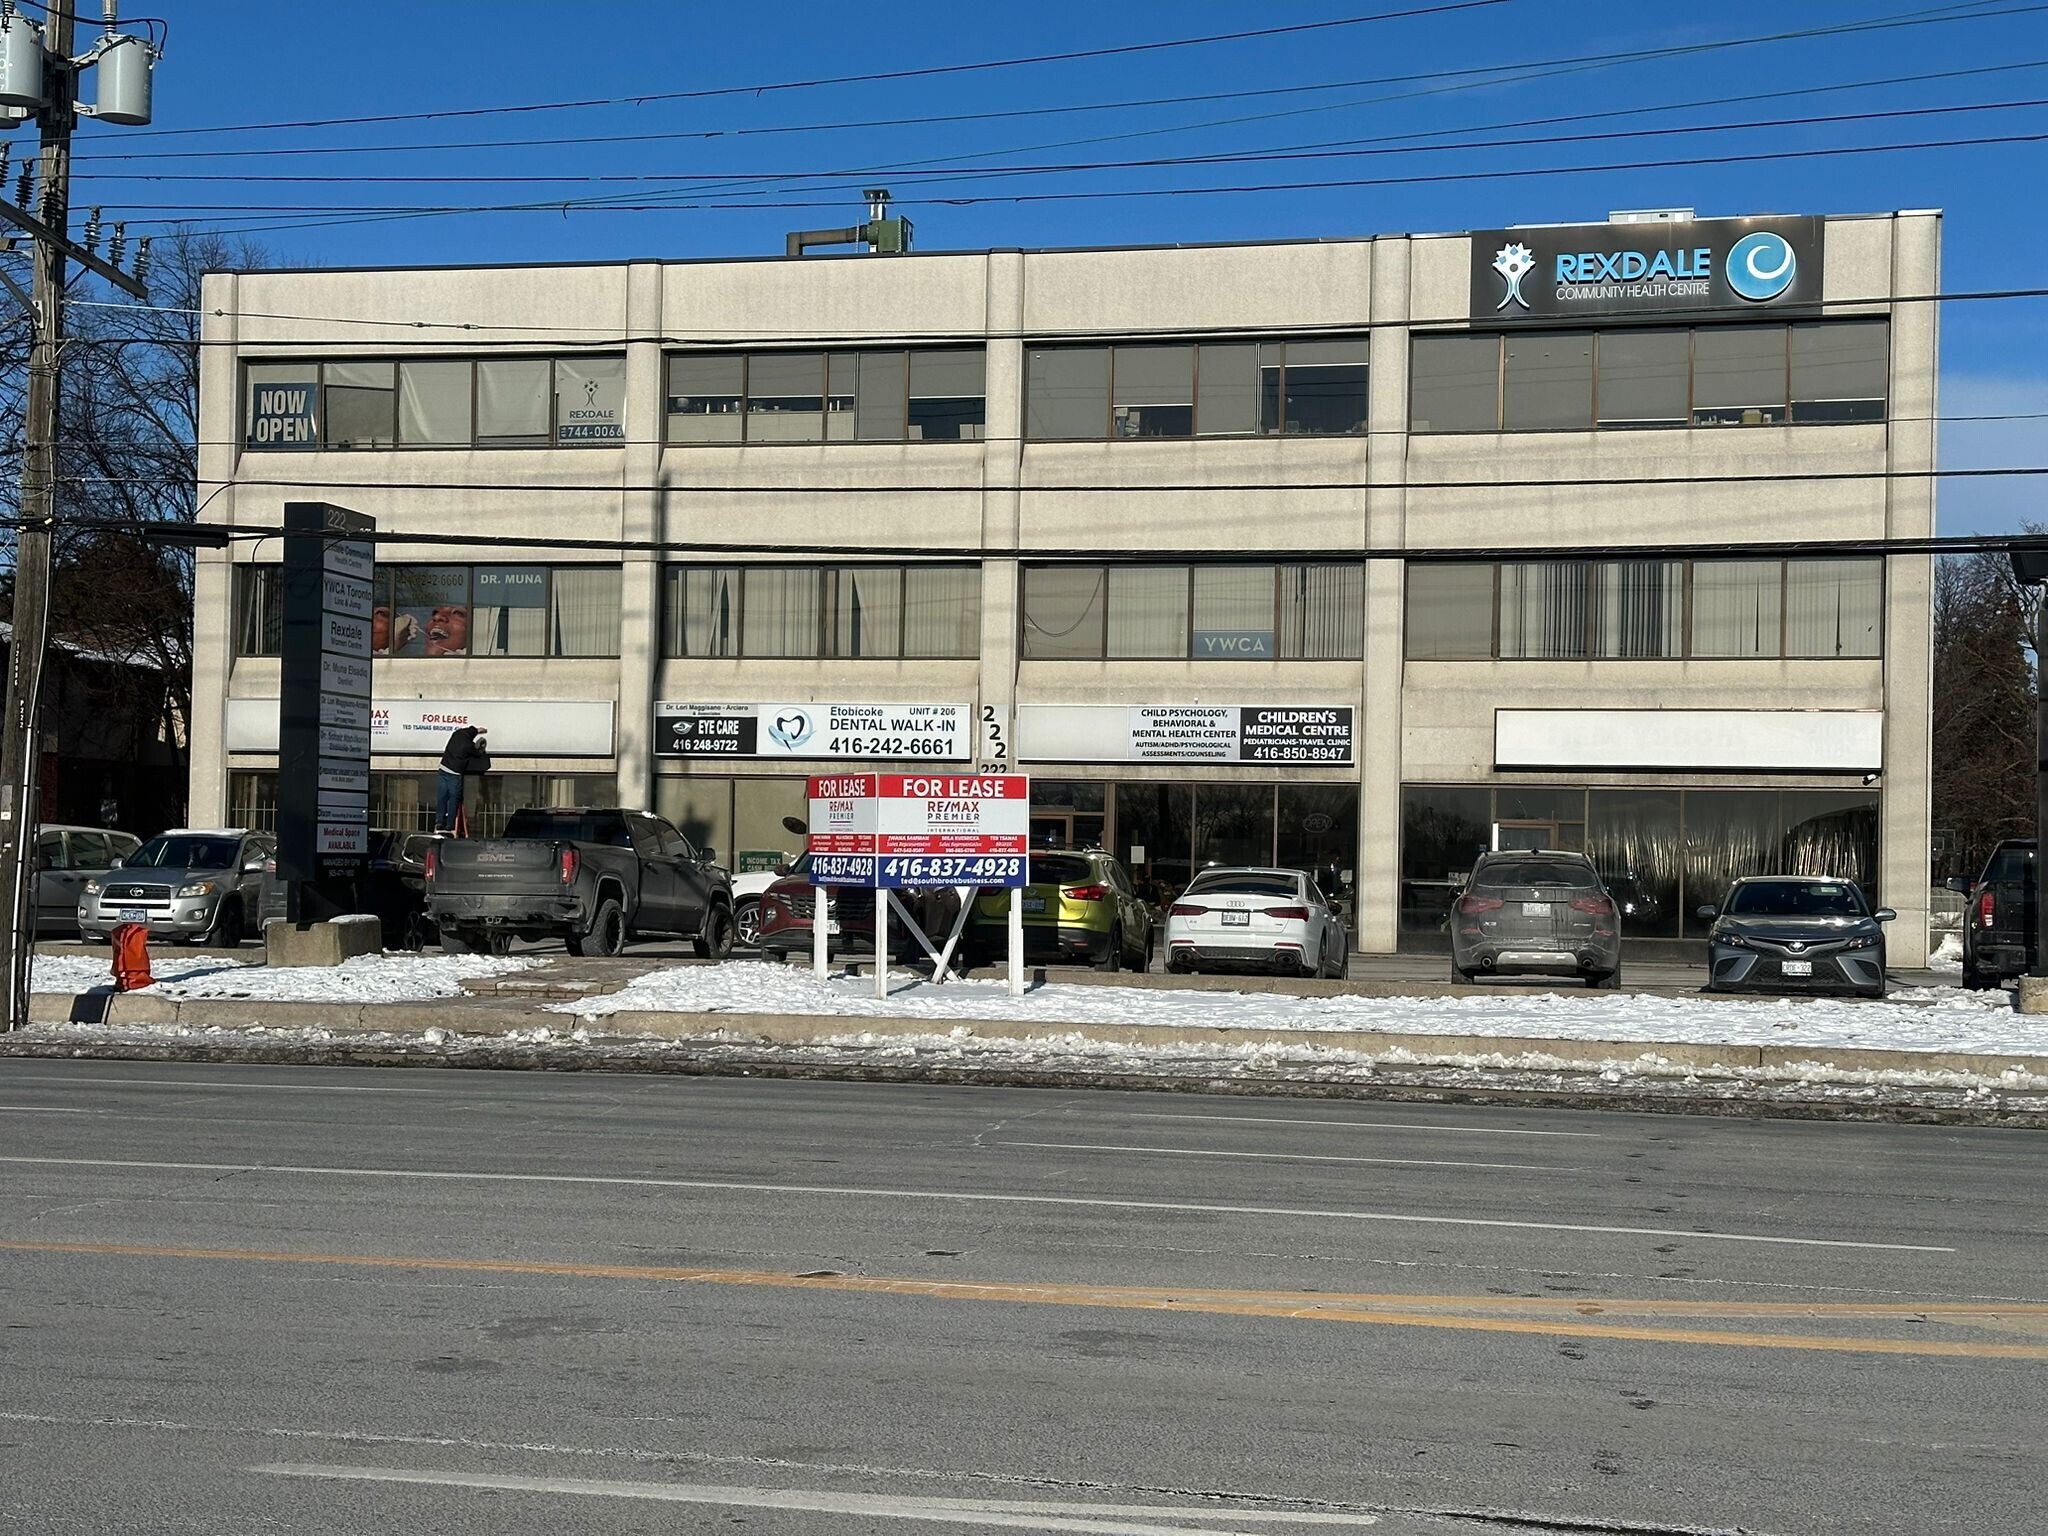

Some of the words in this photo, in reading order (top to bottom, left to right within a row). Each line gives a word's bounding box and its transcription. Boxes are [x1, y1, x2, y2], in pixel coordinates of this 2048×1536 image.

[1557, 248, 1711, 283] REXDALE
[1556, 286, 1626, 301] COMMUNITY
[1627, 284, 1667, 298] HEALTH
[1668, 282, 1710, 296] CENTRE
[260, 390, 307, 415] NOW
[569, 410, 614, 419] REXDALE
[256, 417, 308, 442] OPEN
[567, 426, 622, 438] 744-0066
[327, 509, 347, 531] 222
[480, 574, 501, 585] DR.
[505, 574, 542, 585] MUNA
[324, 579, 346, 596] YWCA
[347, 584, 372, 602] Toronto
[330, 621, 362, 640] Rexdale
[1204, 637, 1265, 652] YWCA
[830, 706, 884, 717] Etobicoke
[909, 707, 931, 716] UNIT
[1141, 709, 1167, 717] CHILD
[1168, 709, 1228, 718] PSYCHOLOGY,
[1257, 710, 1337, 723] CHILDREN'S
[422, 714, 440, 723] FOR
[442, 715, 468, 724] LEASE
[830, 718, 887, 731] DENTAL
[891, 719, 934, 732] WALK
[1153, 719, 1208, 728] BEHAVIORAL
[1209, 720, 1216, 728] &
[698, 719, 715, 735] EYE
[716, 719, 739, 735] CARE
[1245, 725, 1299, 736] MEDICAL
[1302, 725, 1349, 736] CENTRE
[1132, 729, 1167, 738] MENTAL
[1168, 729, 1202, 738] HEALTH
[1203, 730, 1237, 738] CENTER
[672, 738, 691, 751] 416
[692, 739, 738, 751] 248-9722
[829, 737, 953, 755] 416-242-6661
[1326, 738, 1351, 746] CLINIC
[1254, 747, 1345, 759] 416-850-8947
[818, 779, 837, 798] FOR
[838, 778, 866, 797] LEASE
[903, 778, 943, 797] FOR
[949, 779, 1004, 798] LEASE
[829, 800, 854, 812] RE/MAX
[927, 801, 980, 812] RE/MAX
[829, 812, 854, 820] PREMIER
[323, 827, 344, 837] Medical
[344, 828, 360, 839] Space
[327, 841, 356, 850] AVAILABLE
[477, 853, 515, 862] GMC
[746, 857, 768, 865] INCOME
[770, 857, 781, 865] TAX
[811, 857, 873, 876] 416-837-4928
[884, 858, 1020, 877] 416-837-4928
[900, 877, 1005, 885] ted@southbrookbusiness.com
